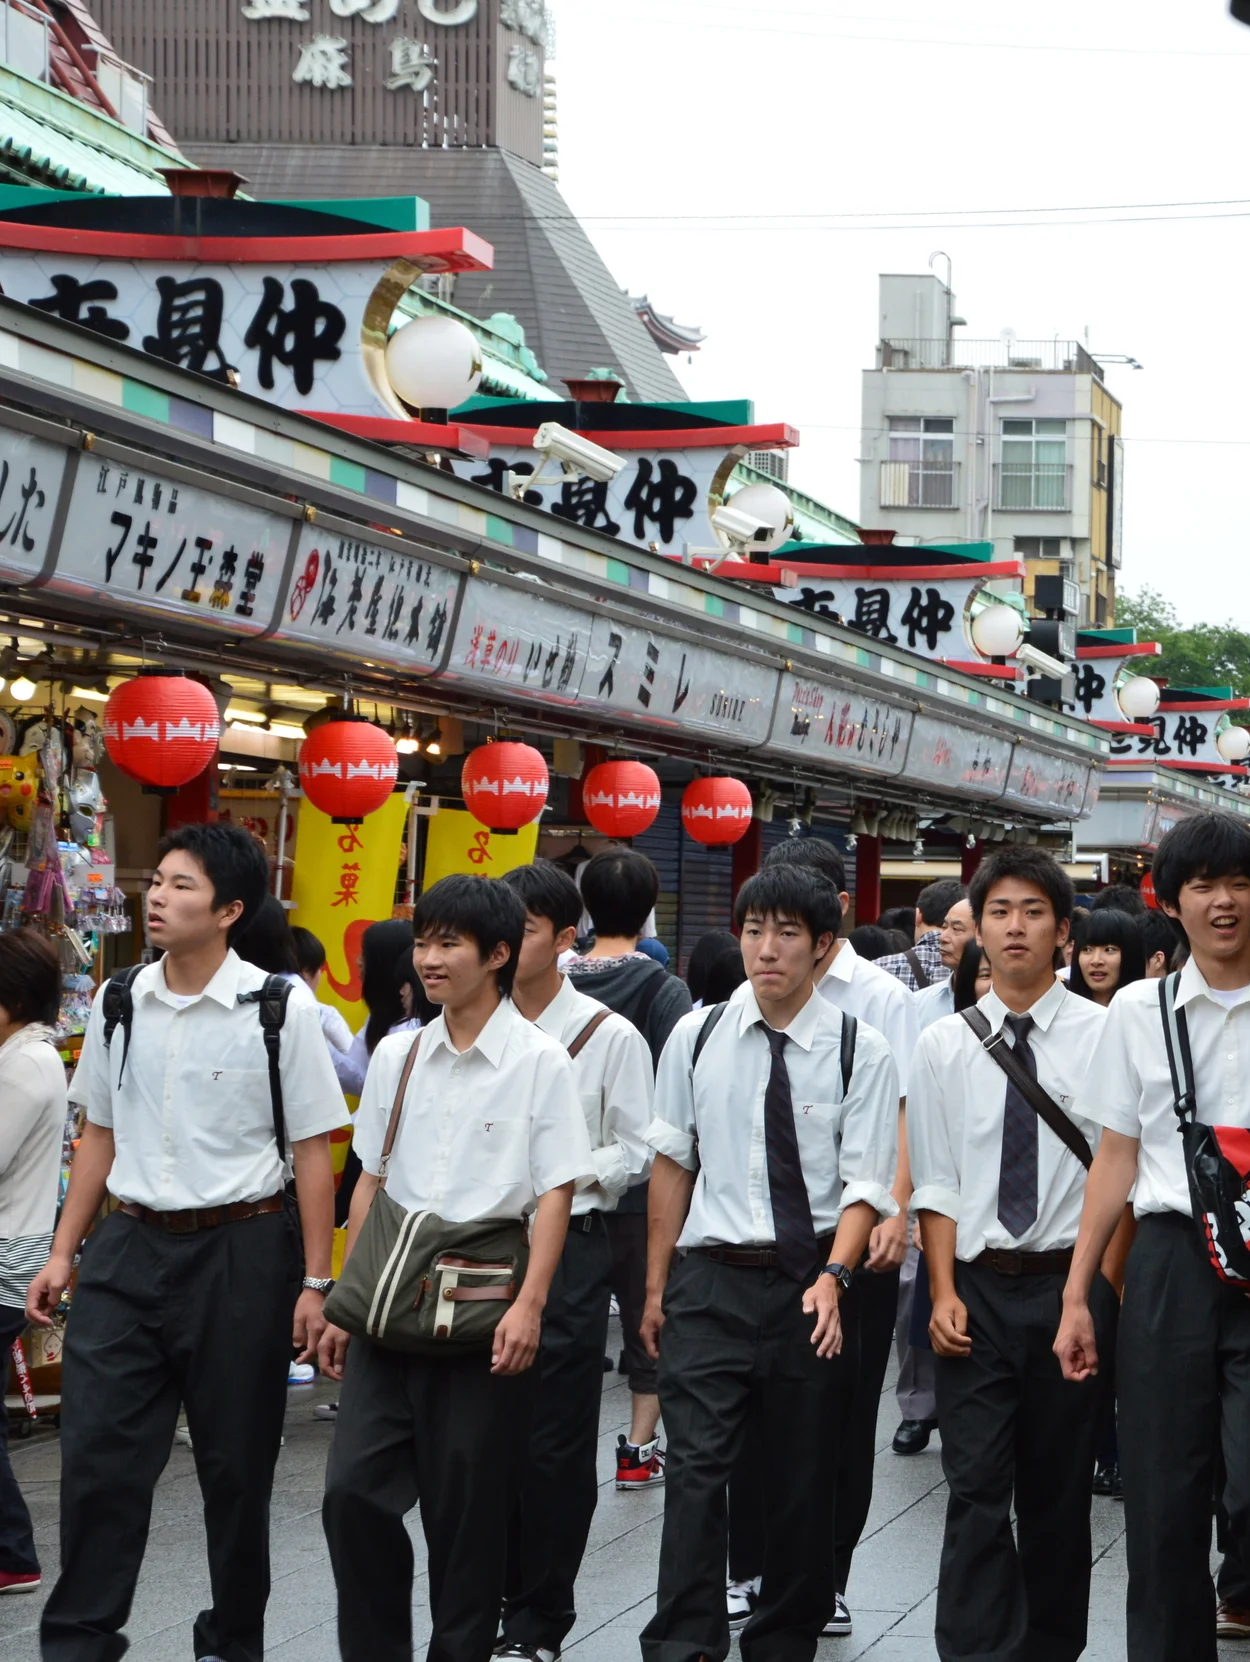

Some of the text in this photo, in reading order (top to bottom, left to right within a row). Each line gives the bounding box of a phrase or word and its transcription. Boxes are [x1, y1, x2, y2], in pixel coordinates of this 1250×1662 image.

[598, 631, 691, 714] スミレ
[709, 692, 746, 723] SUMIRE
[212, 1070, 224, 1081] T
[1059, 1094, 1069, 1104] T
[803, 1104, 813, 1115] T
[484, 1122, 494, 1132] T
